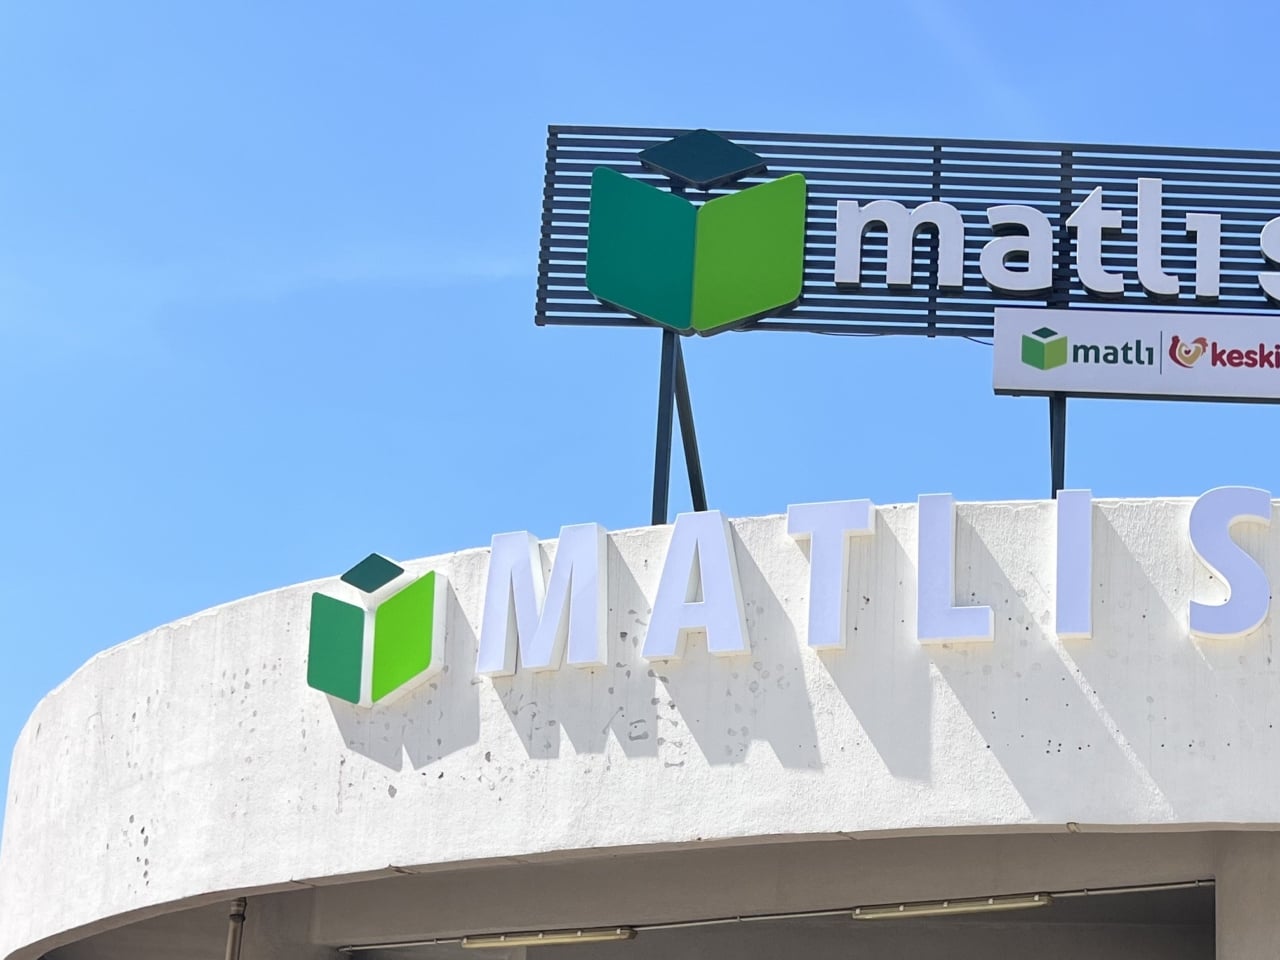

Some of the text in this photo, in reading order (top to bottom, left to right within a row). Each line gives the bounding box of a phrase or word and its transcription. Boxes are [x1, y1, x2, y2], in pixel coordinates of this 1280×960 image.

[834, 177, 1221, 299] matlı
[1072, 339, 1154, 366] matlı
[475, 489, 1093, 676] MATLI
